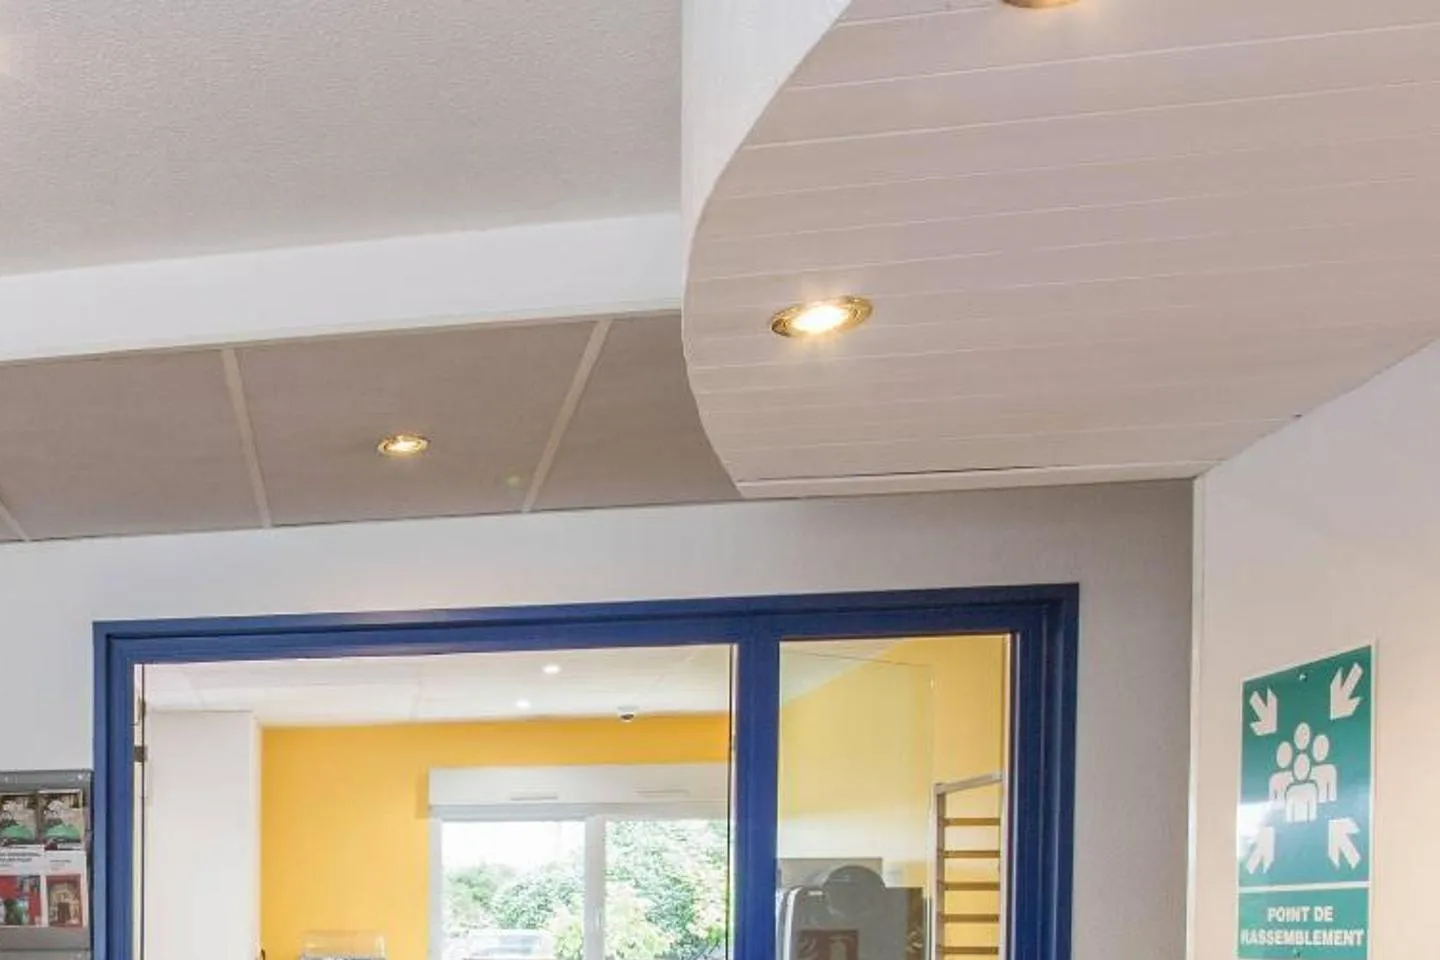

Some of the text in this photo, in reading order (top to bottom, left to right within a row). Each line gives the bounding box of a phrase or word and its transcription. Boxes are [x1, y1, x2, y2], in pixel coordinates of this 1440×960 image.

[1266, 906, 1334, 922] POINT DE
[1240, 929, 1364, 946] RASSEMBLEMENT
